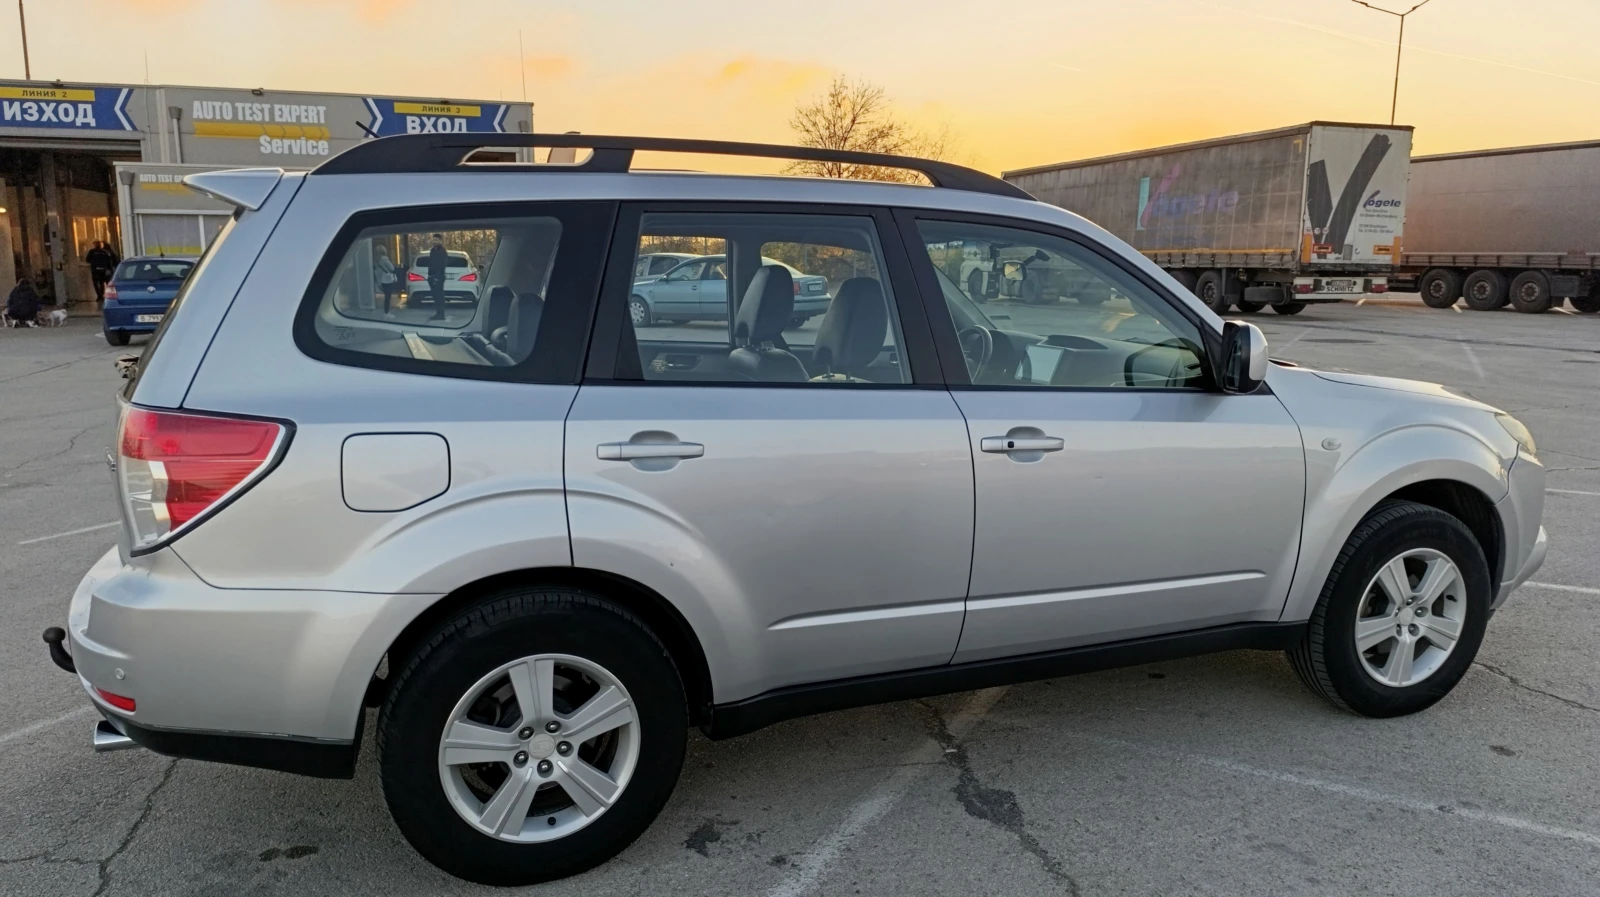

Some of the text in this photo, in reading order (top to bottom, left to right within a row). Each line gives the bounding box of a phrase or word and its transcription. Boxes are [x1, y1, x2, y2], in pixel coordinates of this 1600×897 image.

[22, 90, 56, 98] ЛИНИЯ
[2, 100, 96, 127] ИЗХОД
[193, 100, 327, 124] AUTO TEST EXPERT
[421, 105, 451, 113] ЛИНИЯ
[406, 115, 469, 133] ВХОД
[259, 135, 329, 156] Service
[139, 173, 157, 182] AUTO
[157, 174, 173, 183] TEST
